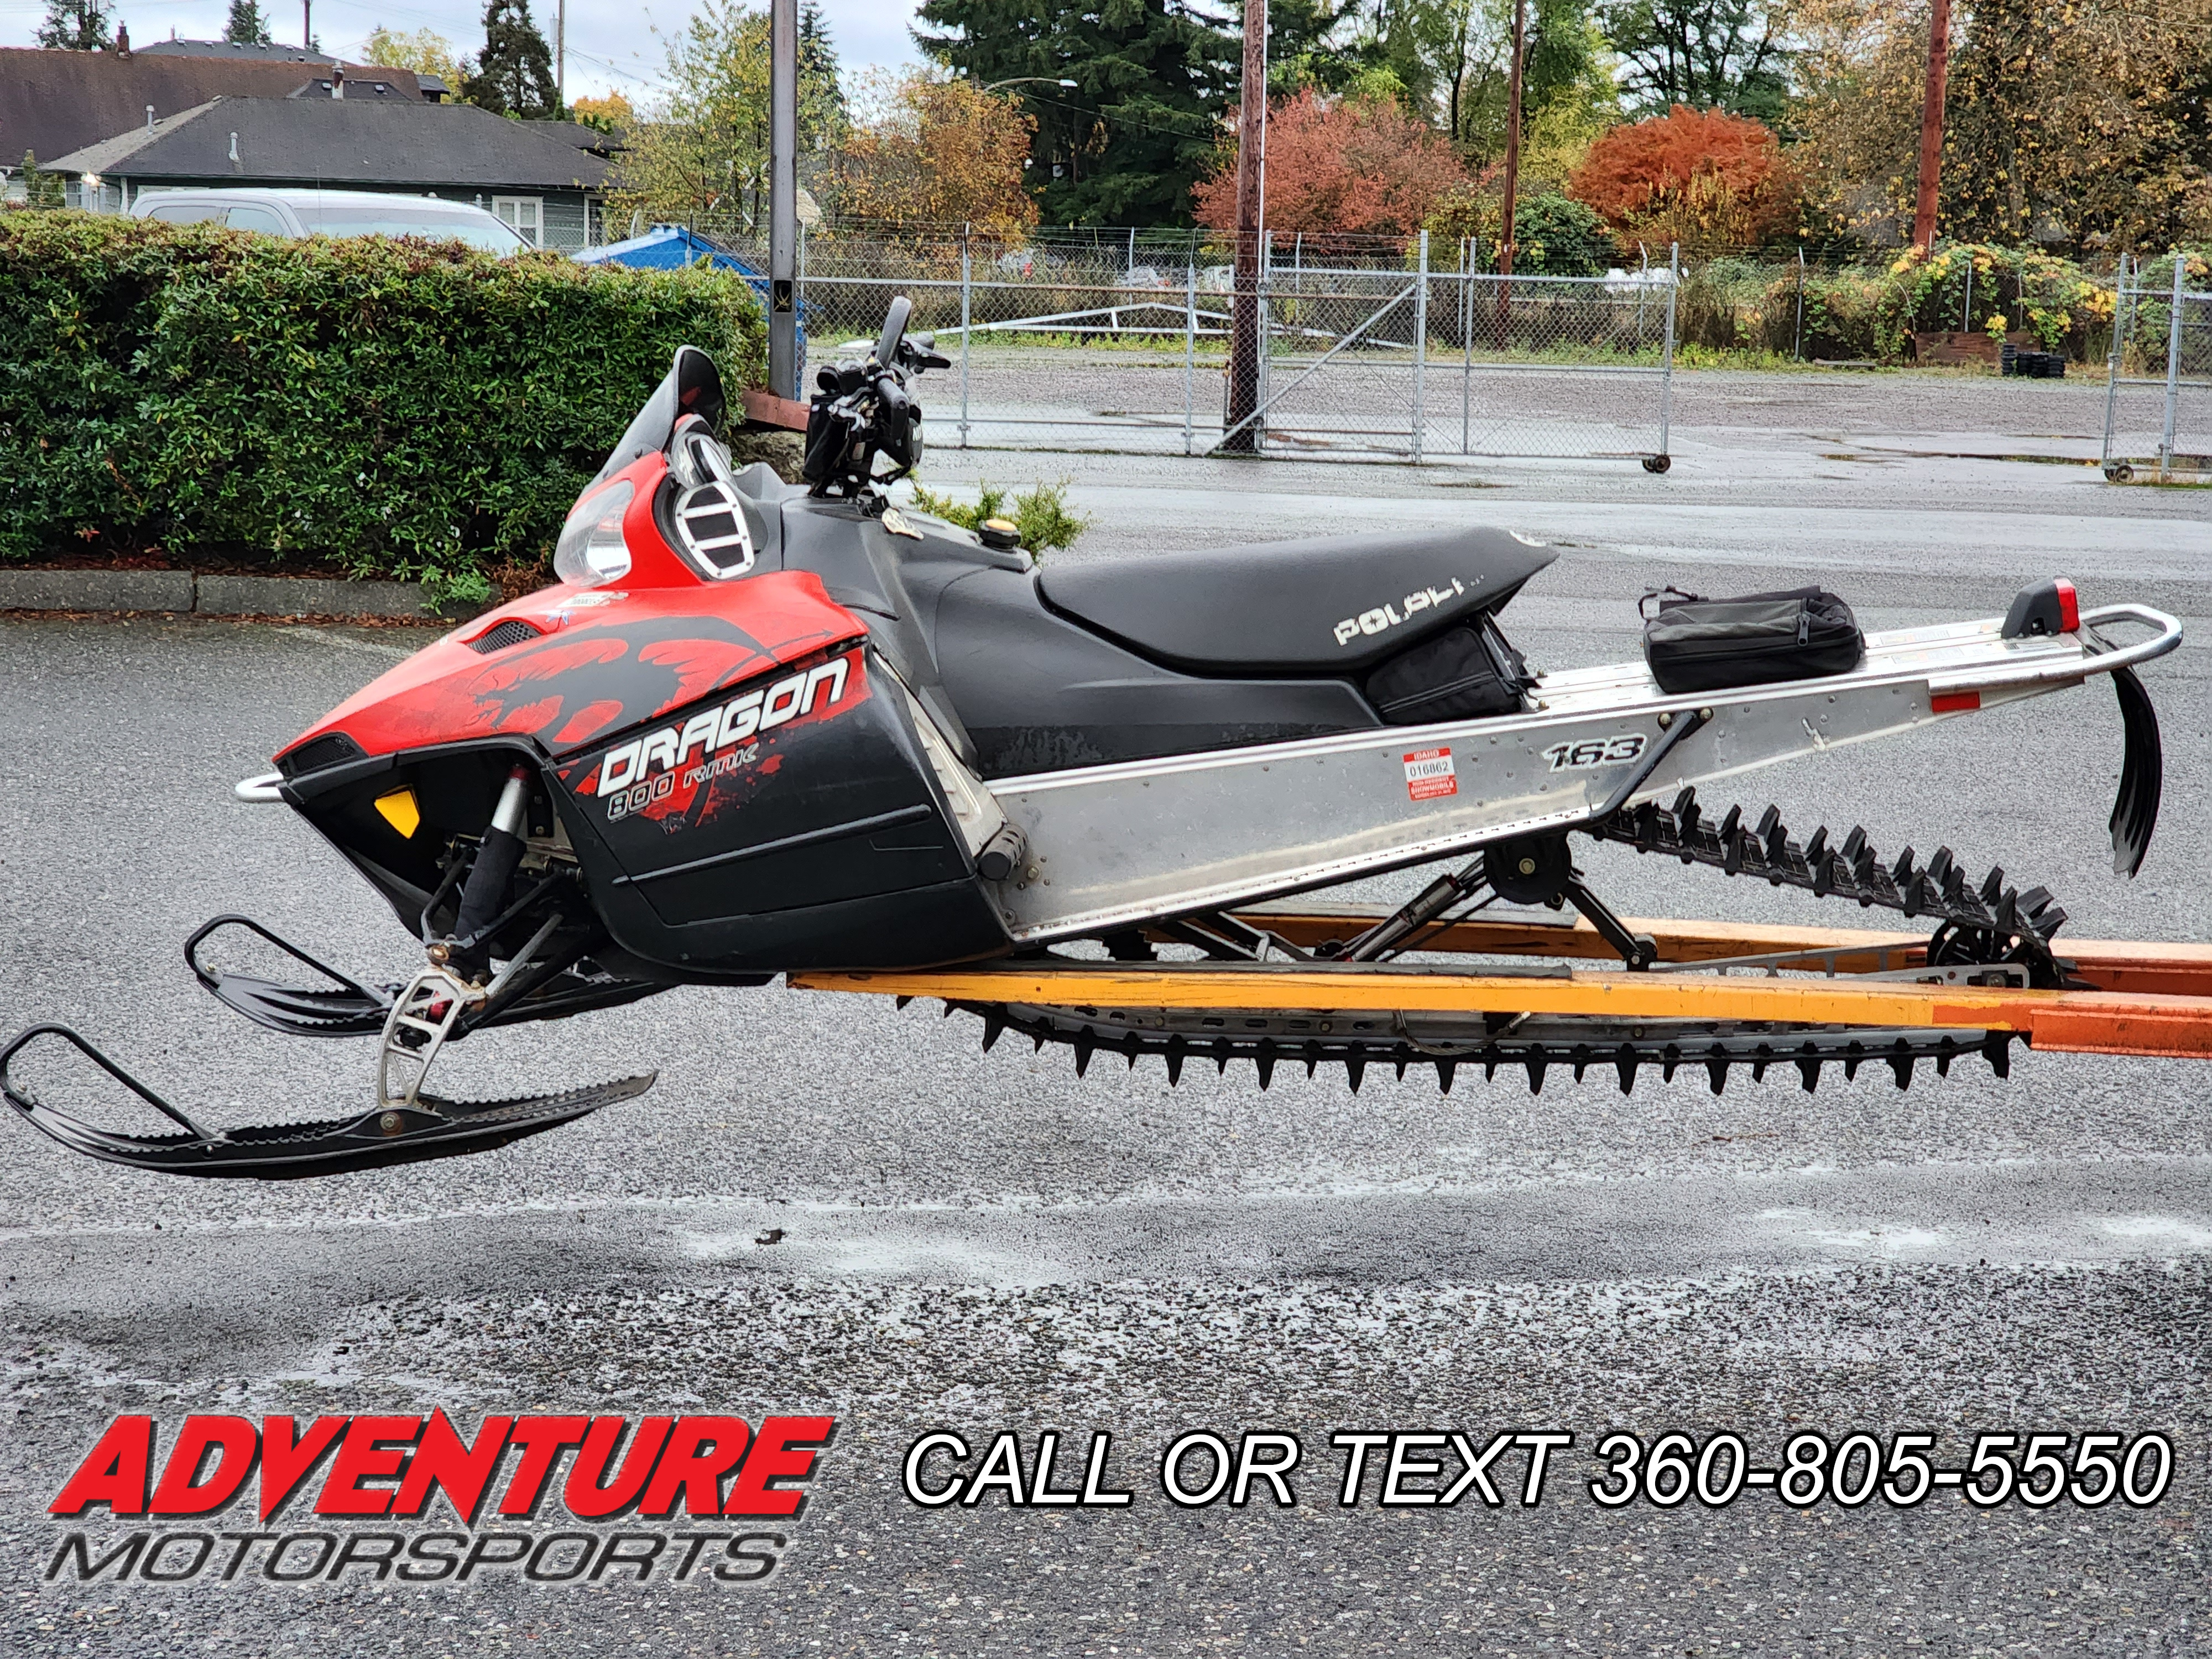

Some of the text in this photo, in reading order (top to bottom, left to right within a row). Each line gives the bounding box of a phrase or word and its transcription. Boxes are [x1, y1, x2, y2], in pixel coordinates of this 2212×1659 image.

[597, 657, 849, 798] DRAGON
[1413, 750, 1439, 760] IDAHO
[1542, 732, 1647, 773] 163
[607, 770, 675, 822] 800
